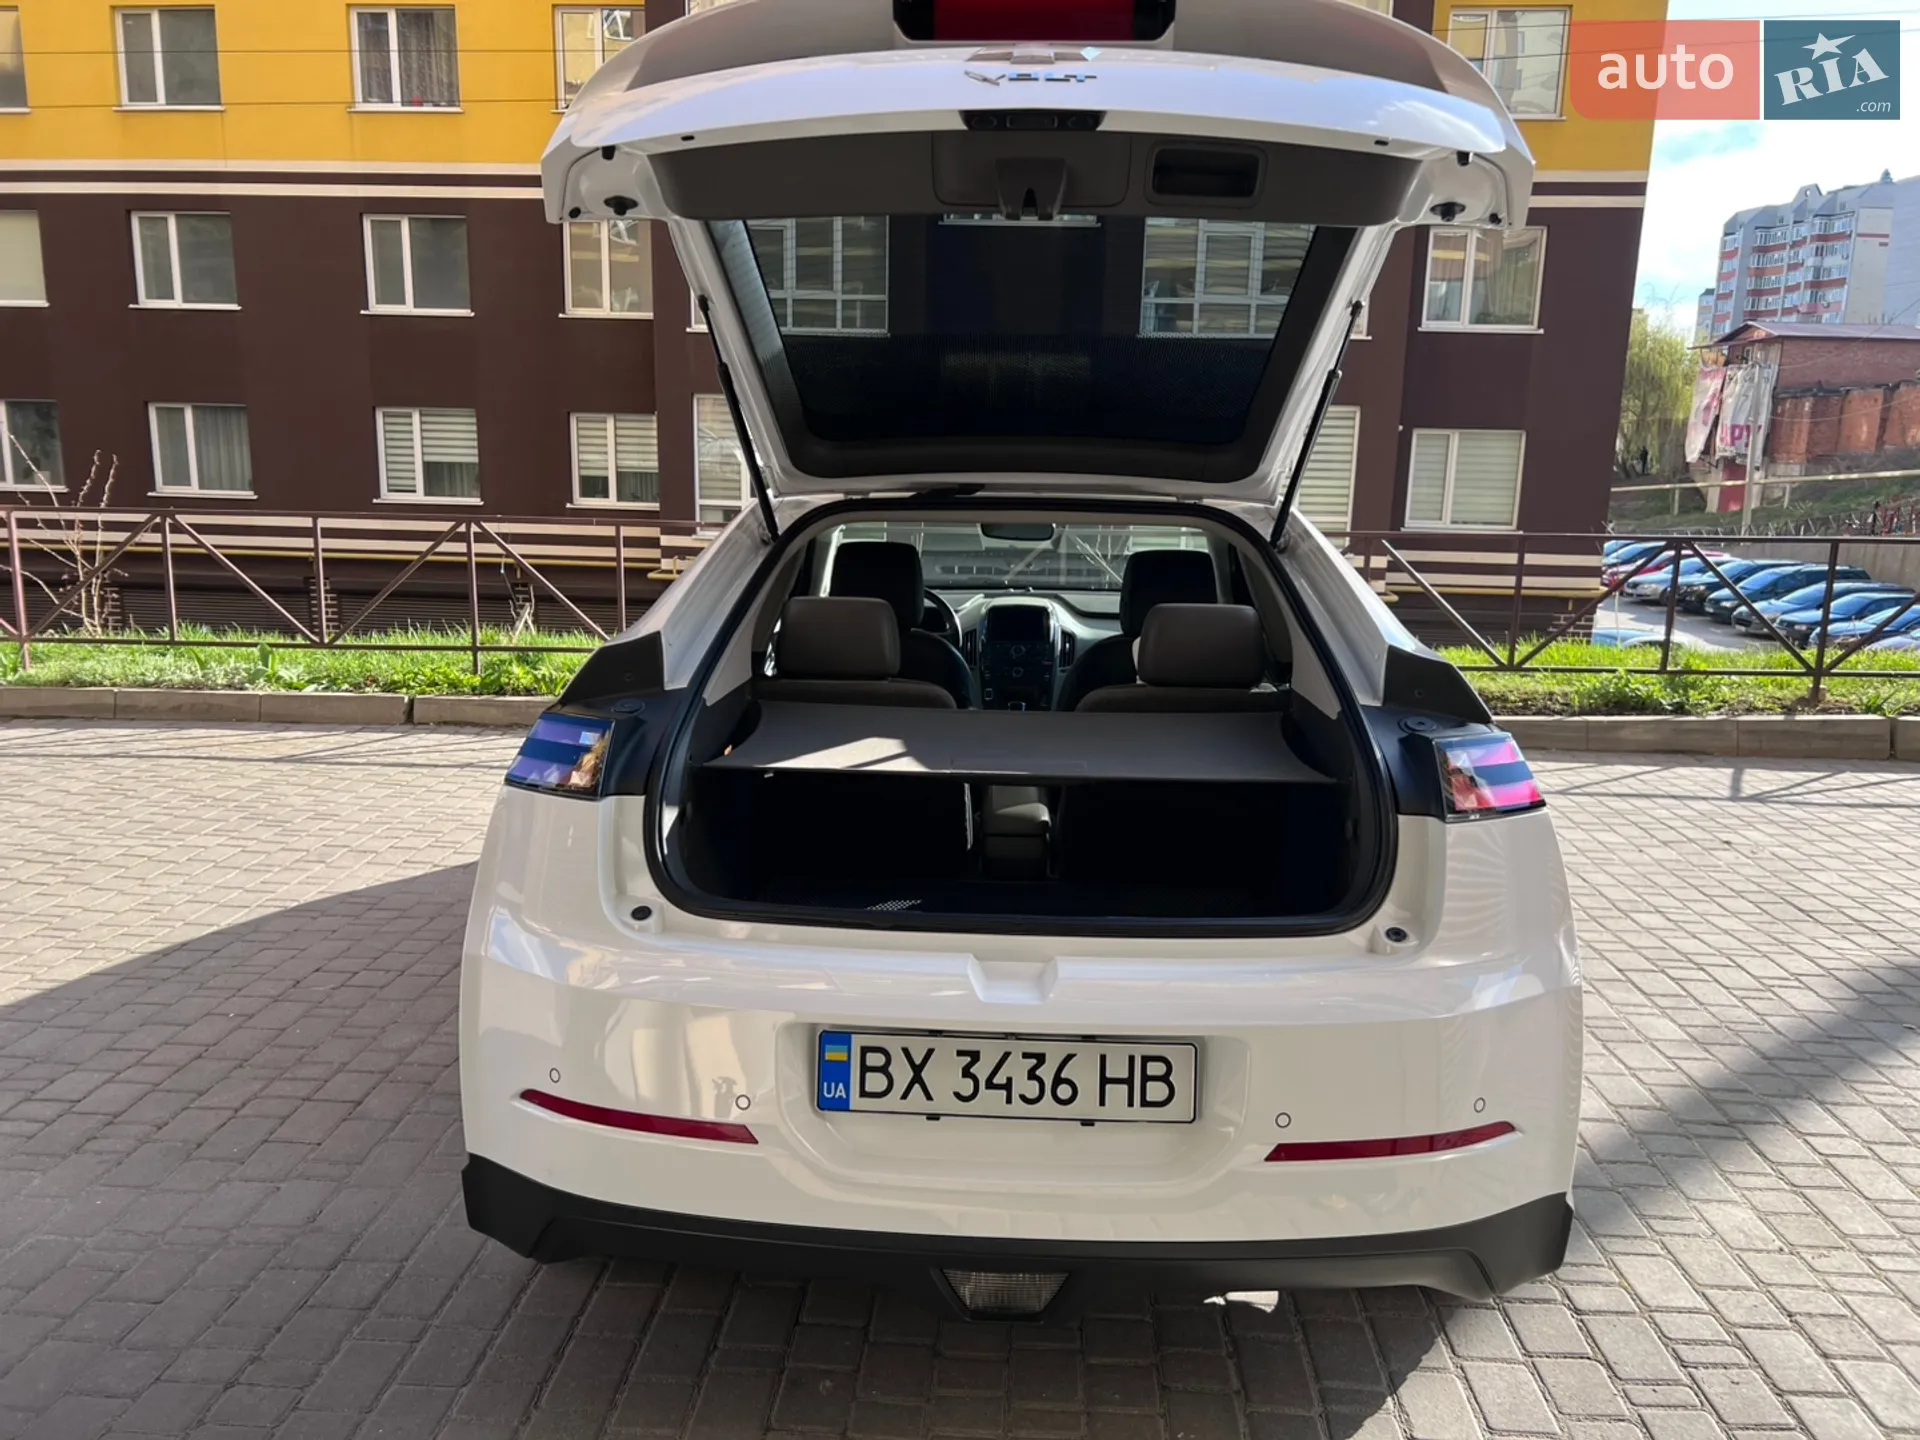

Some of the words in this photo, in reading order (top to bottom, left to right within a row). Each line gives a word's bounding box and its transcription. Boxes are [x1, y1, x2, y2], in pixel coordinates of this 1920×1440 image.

[823, 1082, 846, 1099] UA
[859, 1046, 935, 1101] BX
[952, 1049, 1079, 1106] 3436
[1099, 1053, 1176, 1108] HB
